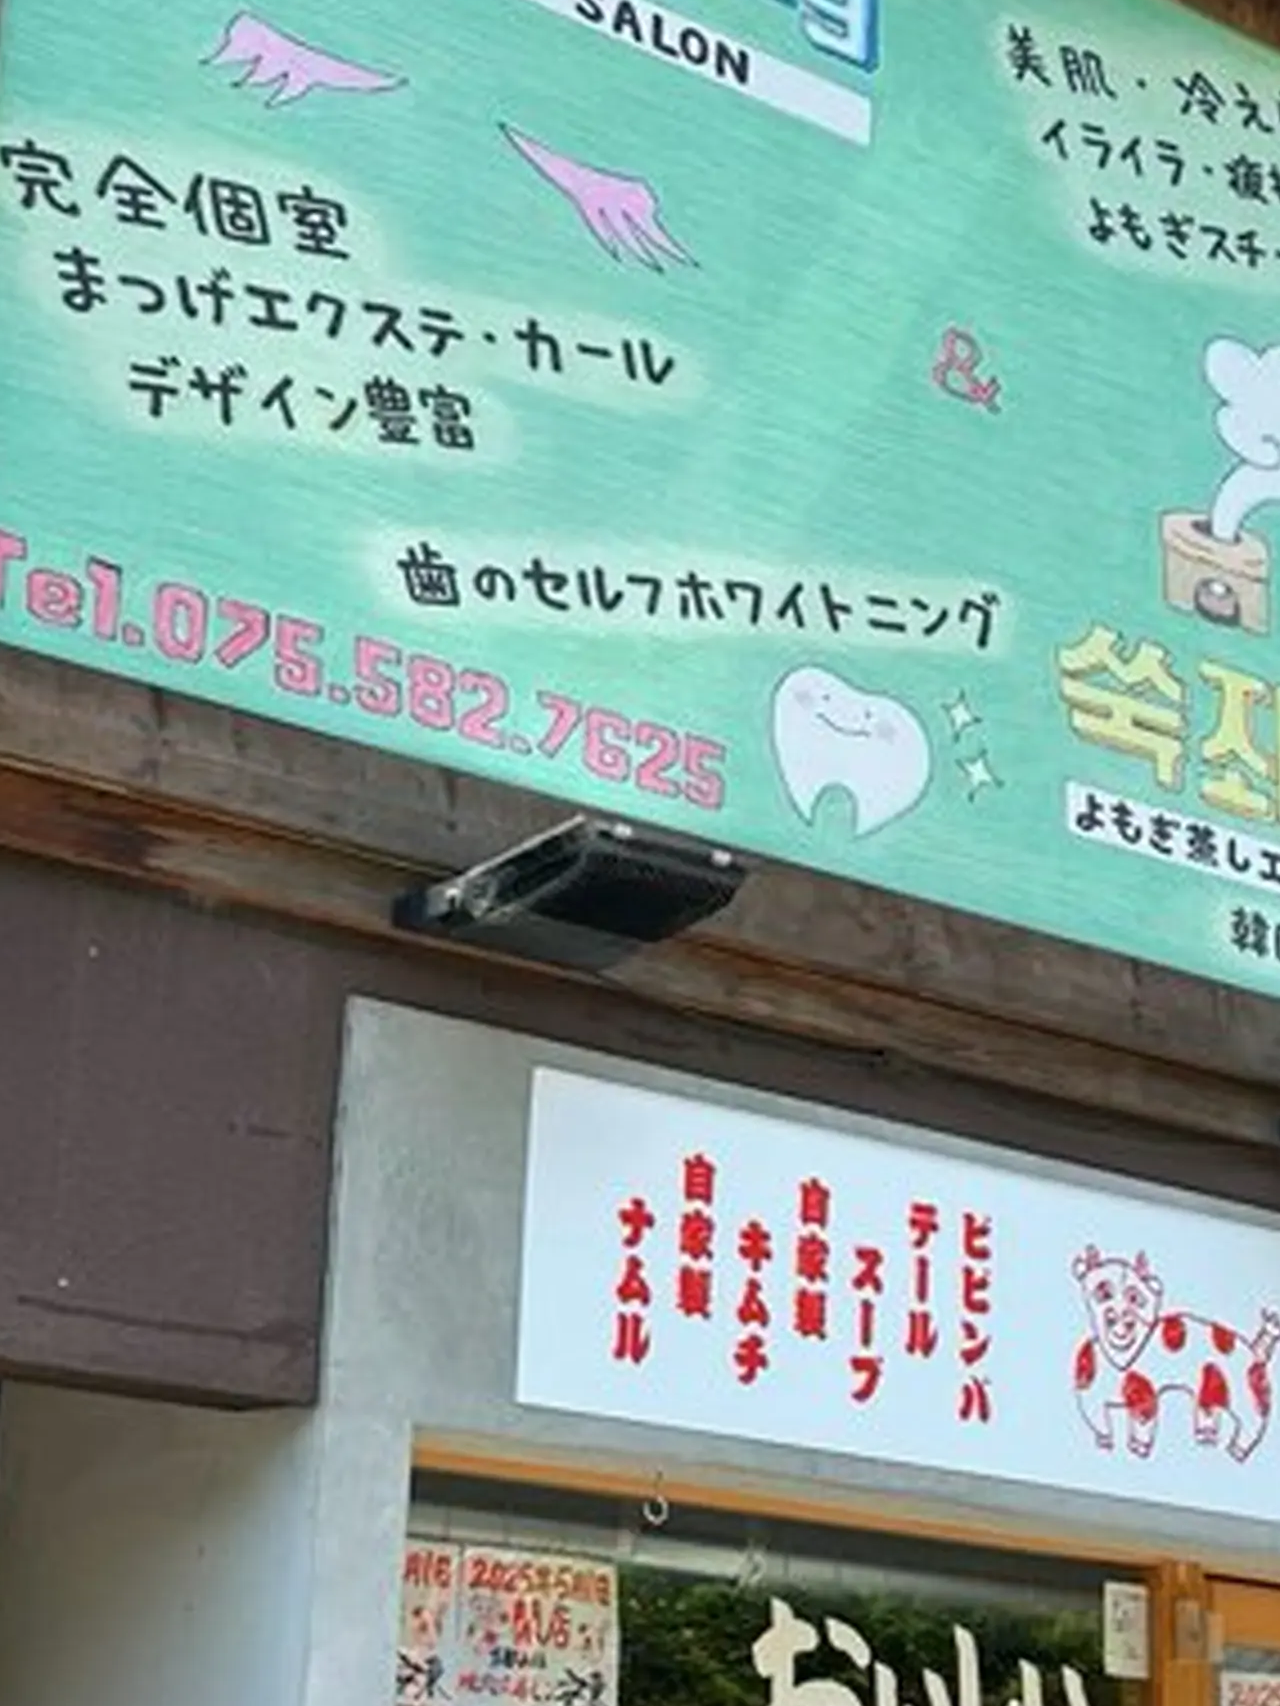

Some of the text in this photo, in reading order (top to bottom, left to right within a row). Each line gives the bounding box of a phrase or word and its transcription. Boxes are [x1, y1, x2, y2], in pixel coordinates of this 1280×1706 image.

[53, 247, 675, 387] まつげエクステ・カール
[932, 327, 1001, 414] &
[127, 355, 477, 452] デザイン豊富
[398, 541, 1001, 650] 歯のセルフホワイトニング
[612, 1197, 655, 1366] ナムル
[732, 1219, 772, 1386] キムチ
[850, 1202, 939, 1403] テール スープ
[958, 1212, 992, 1422] ビビンバ
